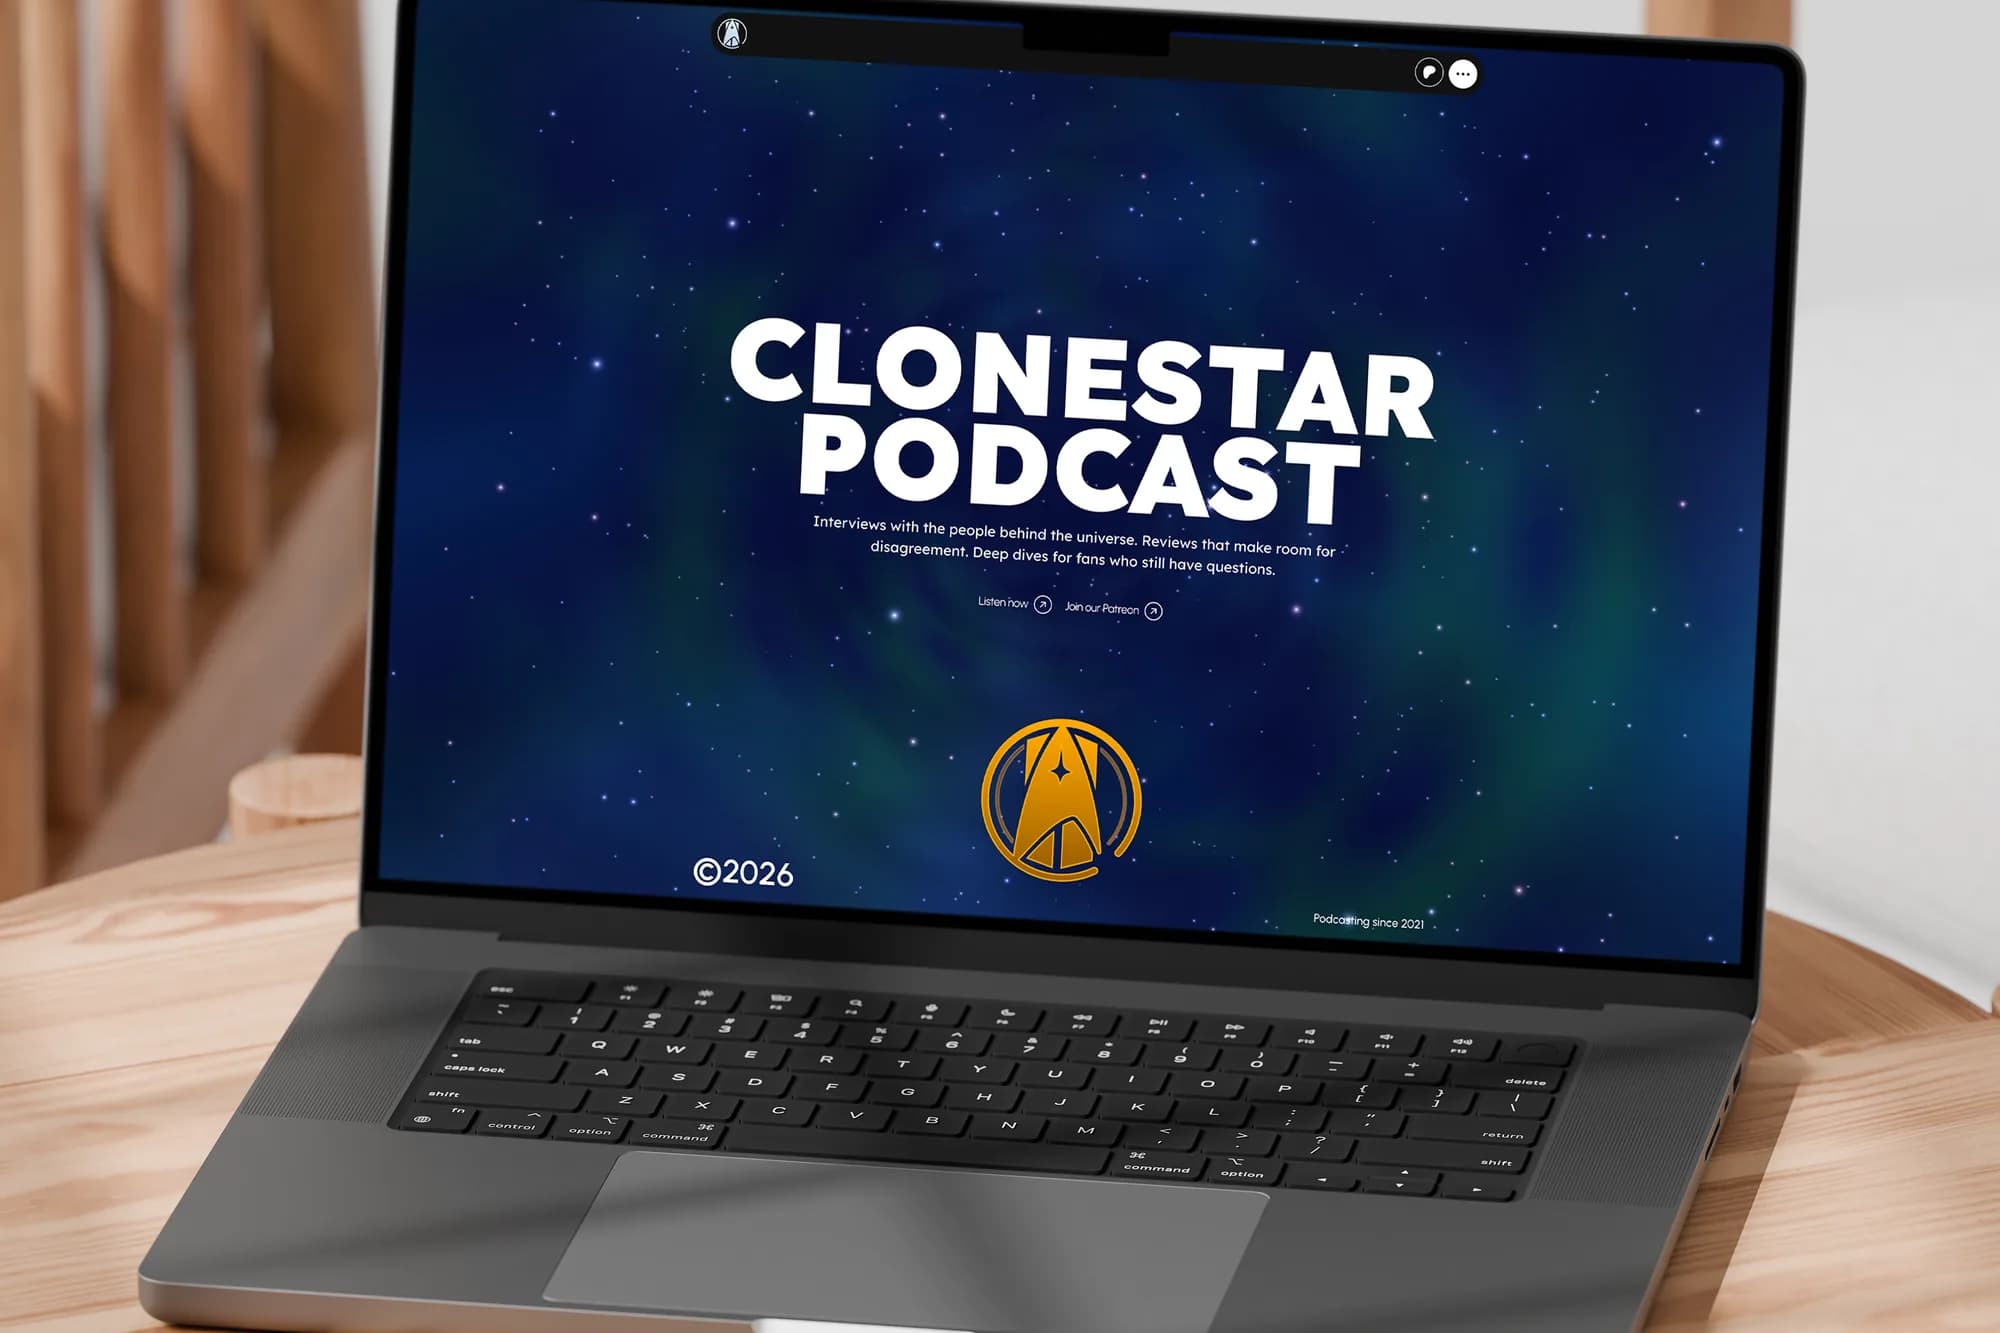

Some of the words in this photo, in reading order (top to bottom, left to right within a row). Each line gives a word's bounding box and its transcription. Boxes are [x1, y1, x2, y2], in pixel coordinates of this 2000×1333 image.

[731, 318, 1436, 441] CLONESTAR
[800, 411, 1361, 526] PODCAST
[814, 516, 886, 530] Interviews
[891, 520, 918, 532] with
[924, 522, 945, 534] the
[950, 525, 995, 539] people
[1000, 526, 1046, 540] behind
[1051, 530, 1072, 541] the
[1077, 532, 1137, 545] universe.
[1143, 535, 1197, 549] Reviews
[1202, 539, 1230, 550] that
[1235, 542, 1271, 553] make
[1276, 546, 1311, 556] room
[1317, 545, 1336, 557] for
[871, 540, 968, 557] disagreement.
[974, 547, 1008, 562] Deep
[1013, 549, 1048, 561] dives
[1053, 551, 1072, 563] for
[1077, 553, 1105, 565] fans
[1110, 555, 1137, 567] who
[1143, 557, 1165, 568] still
[1170, 558, 1202, 571] have
[1207, 562, 1275, 575] questions.
[979, 596, 1006, 606] Listen
[1008, 600, 1029, 608] now
[1065, 602, 1083, 611] Join
[1102, 604, 1139, 614] Patreon
[694, 858, 793, 886] ©2026
[1314, 913, 1369, 928] Podcasting
[1373, 918, 1398, 927] since
[1401, 919, 1423, 929] 2021
[592, 1041, 606, 1049] Q
[1124, 1165, 1190, 1173] command
